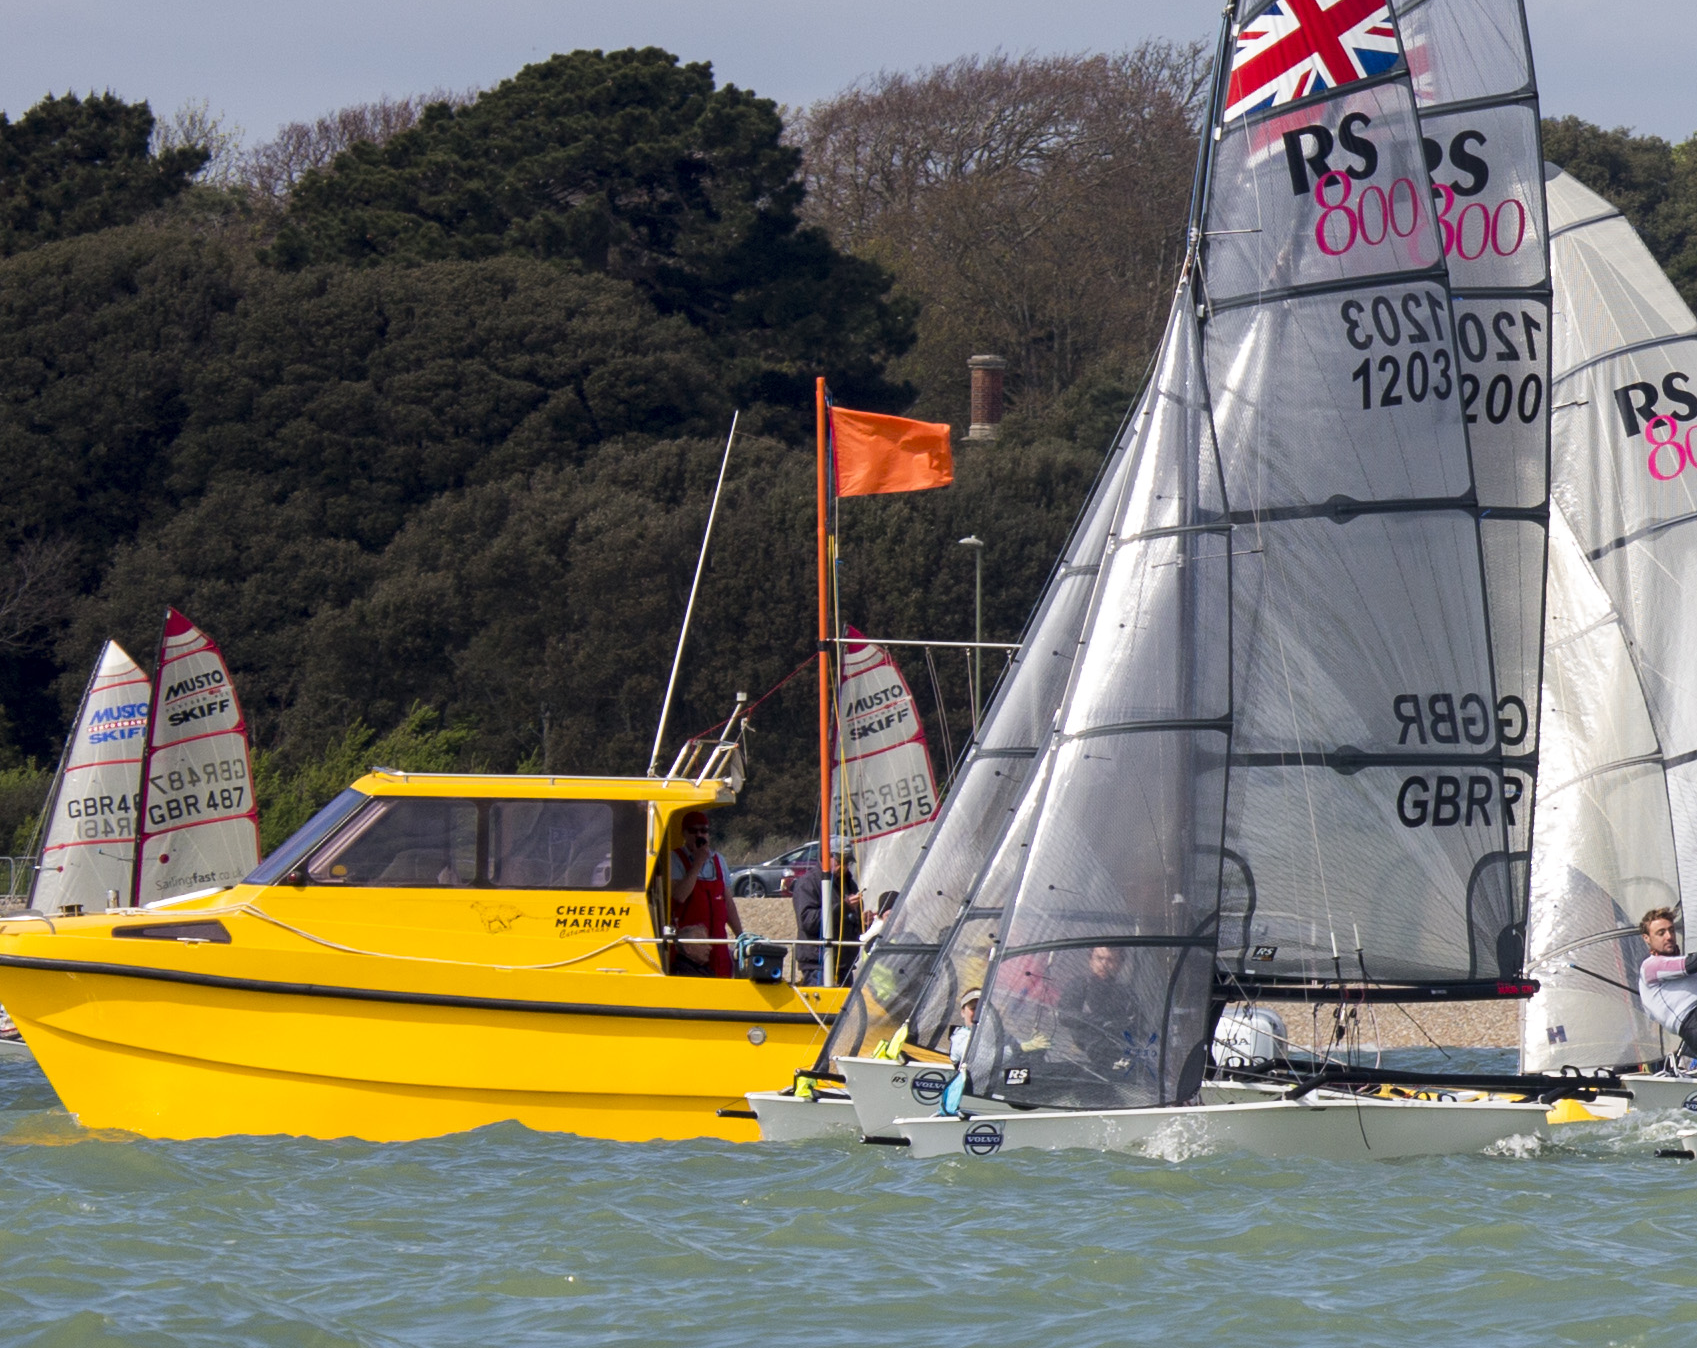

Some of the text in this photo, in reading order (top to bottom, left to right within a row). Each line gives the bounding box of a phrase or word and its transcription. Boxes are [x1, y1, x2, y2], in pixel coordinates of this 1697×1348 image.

[1282, 111, 1379, 197] RS
[1314, 170, 1419, 257] 800
[1352, 348, 1452, 410] 1203
[1461, 373, 1542, 424] 200
[165, 670, 223, 701] MUSTO
[846, 685, 903, 717] MUSTO
[168, 699, 230, 727] SKIFF
[850, 708, 909, 741] SKIFF
[1398, 775, 1492, 828] GBR
[555, 918, 621, 929] MARINE
[556, 905, 630, 916] CHEETAH
[1256, 947, 1275, 956] RS
[892, 1076, 907, 1084] RS
[1008, 1069, 1029, 1079] RS
[967, 1136, 1001, 1144] VOLVO
